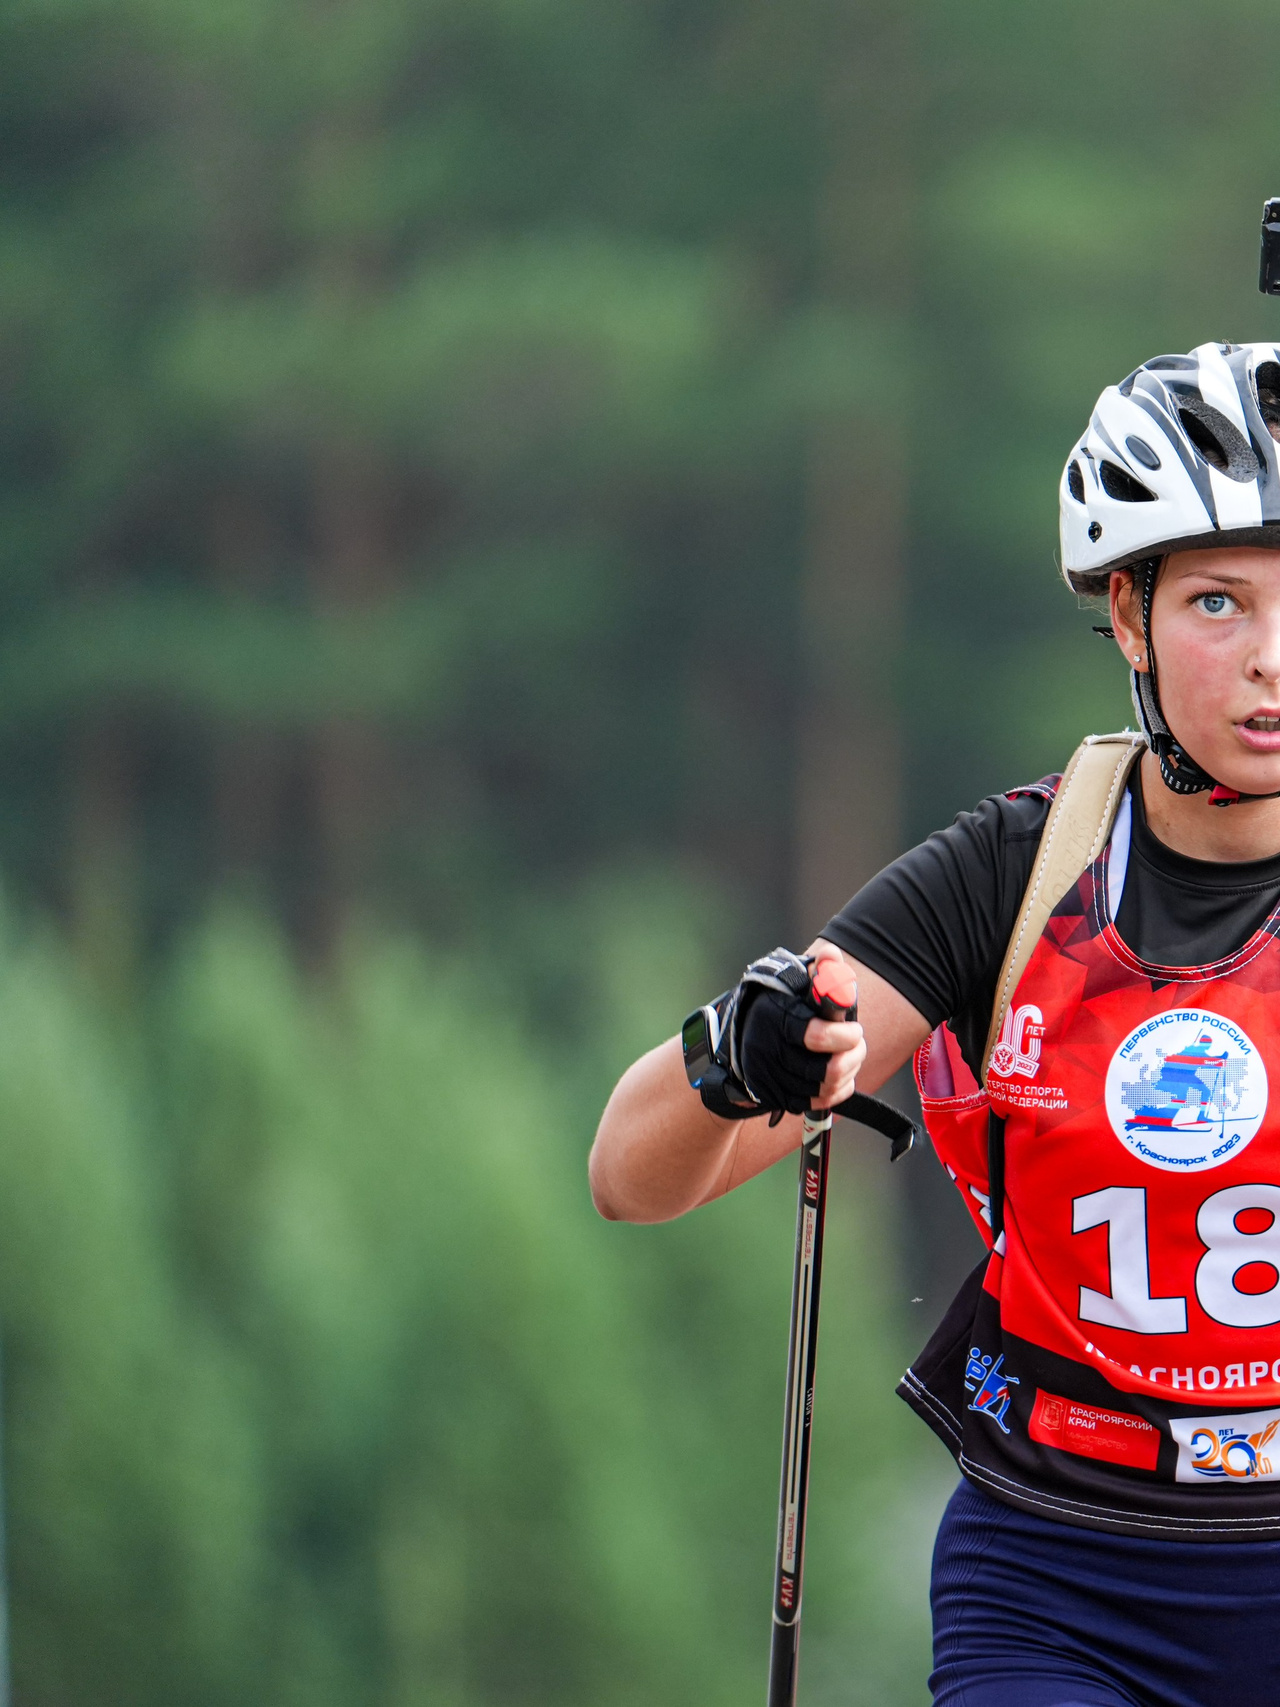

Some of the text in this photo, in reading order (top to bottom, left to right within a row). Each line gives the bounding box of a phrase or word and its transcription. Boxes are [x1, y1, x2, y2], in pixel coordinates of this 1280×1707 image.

[1025, 1025, 1046, 1036] ЛЕТ
[1119, 1012, 1252, 1058] ПЕРВЕНСТВО РОССИИ
[1017, 1061, 1032, 1071] 2023
[1024, 1086, 1064, 1097] СПОРТА
[1008, 1096, 1068, 1110] ФЕДЕРАЦИИ
[1135, 1141, 1208, 1167] Красноярск
[1211, 1133, 1242, 1159] 2023
[1067, 1415, 1096, 1431] КРАЙ
[1070, 1405, 1153, 1432] КРАСНОЯРСКИЙ
[1218, 1428, 1235, 1436] ЛЕТ
[1191, 1427, 1257, 1477] 20
